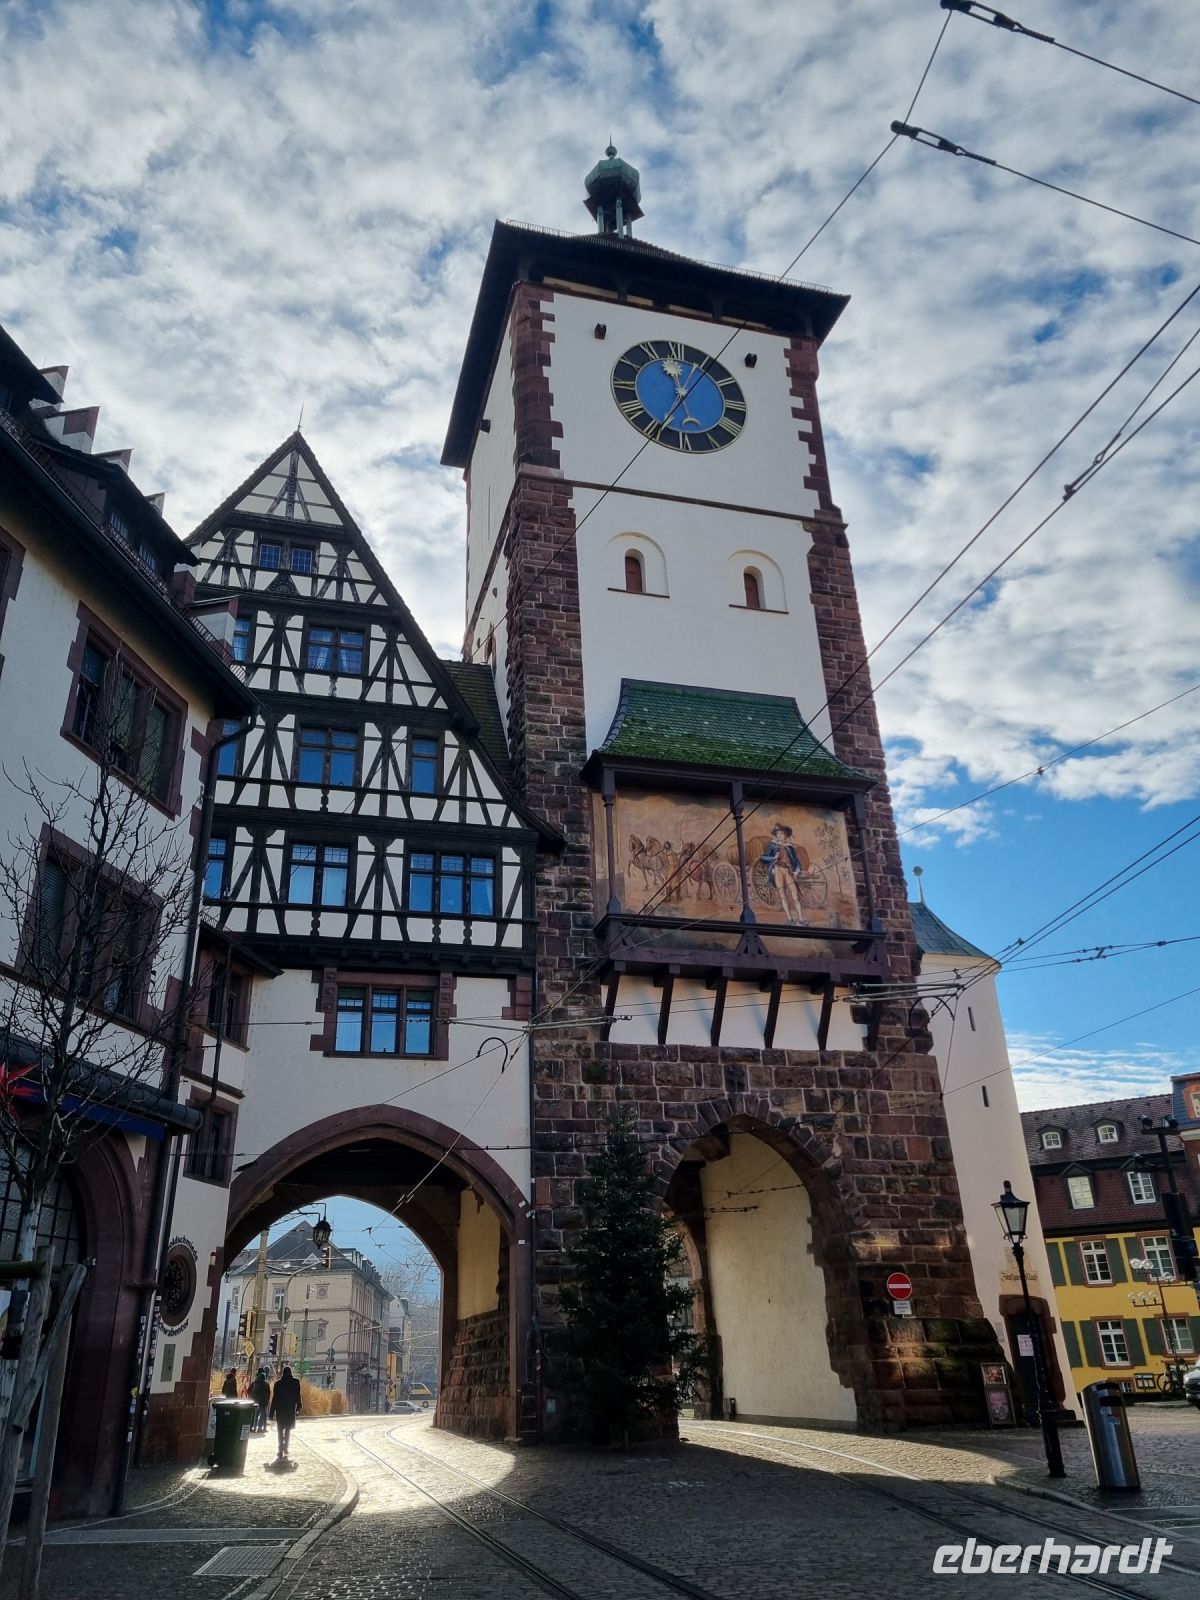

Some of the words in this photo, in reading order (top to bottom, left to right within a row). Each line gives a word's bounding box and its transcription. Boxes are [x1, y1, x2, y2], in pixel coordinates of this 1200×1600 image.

[639, 341, 659, 361] XI
[668, 341, 685, 361] XII
[619, 355, 641, 372] X
[699, 355, 710, 369] I
[612, 376, 636, 391] IX
[716, 376, 737, 387] II
[619, 399, 645, 421] VIII
[724, 399, 747, 412] III
[679, 431, 693, 451] VI
[706, 432, 722, 450] V
